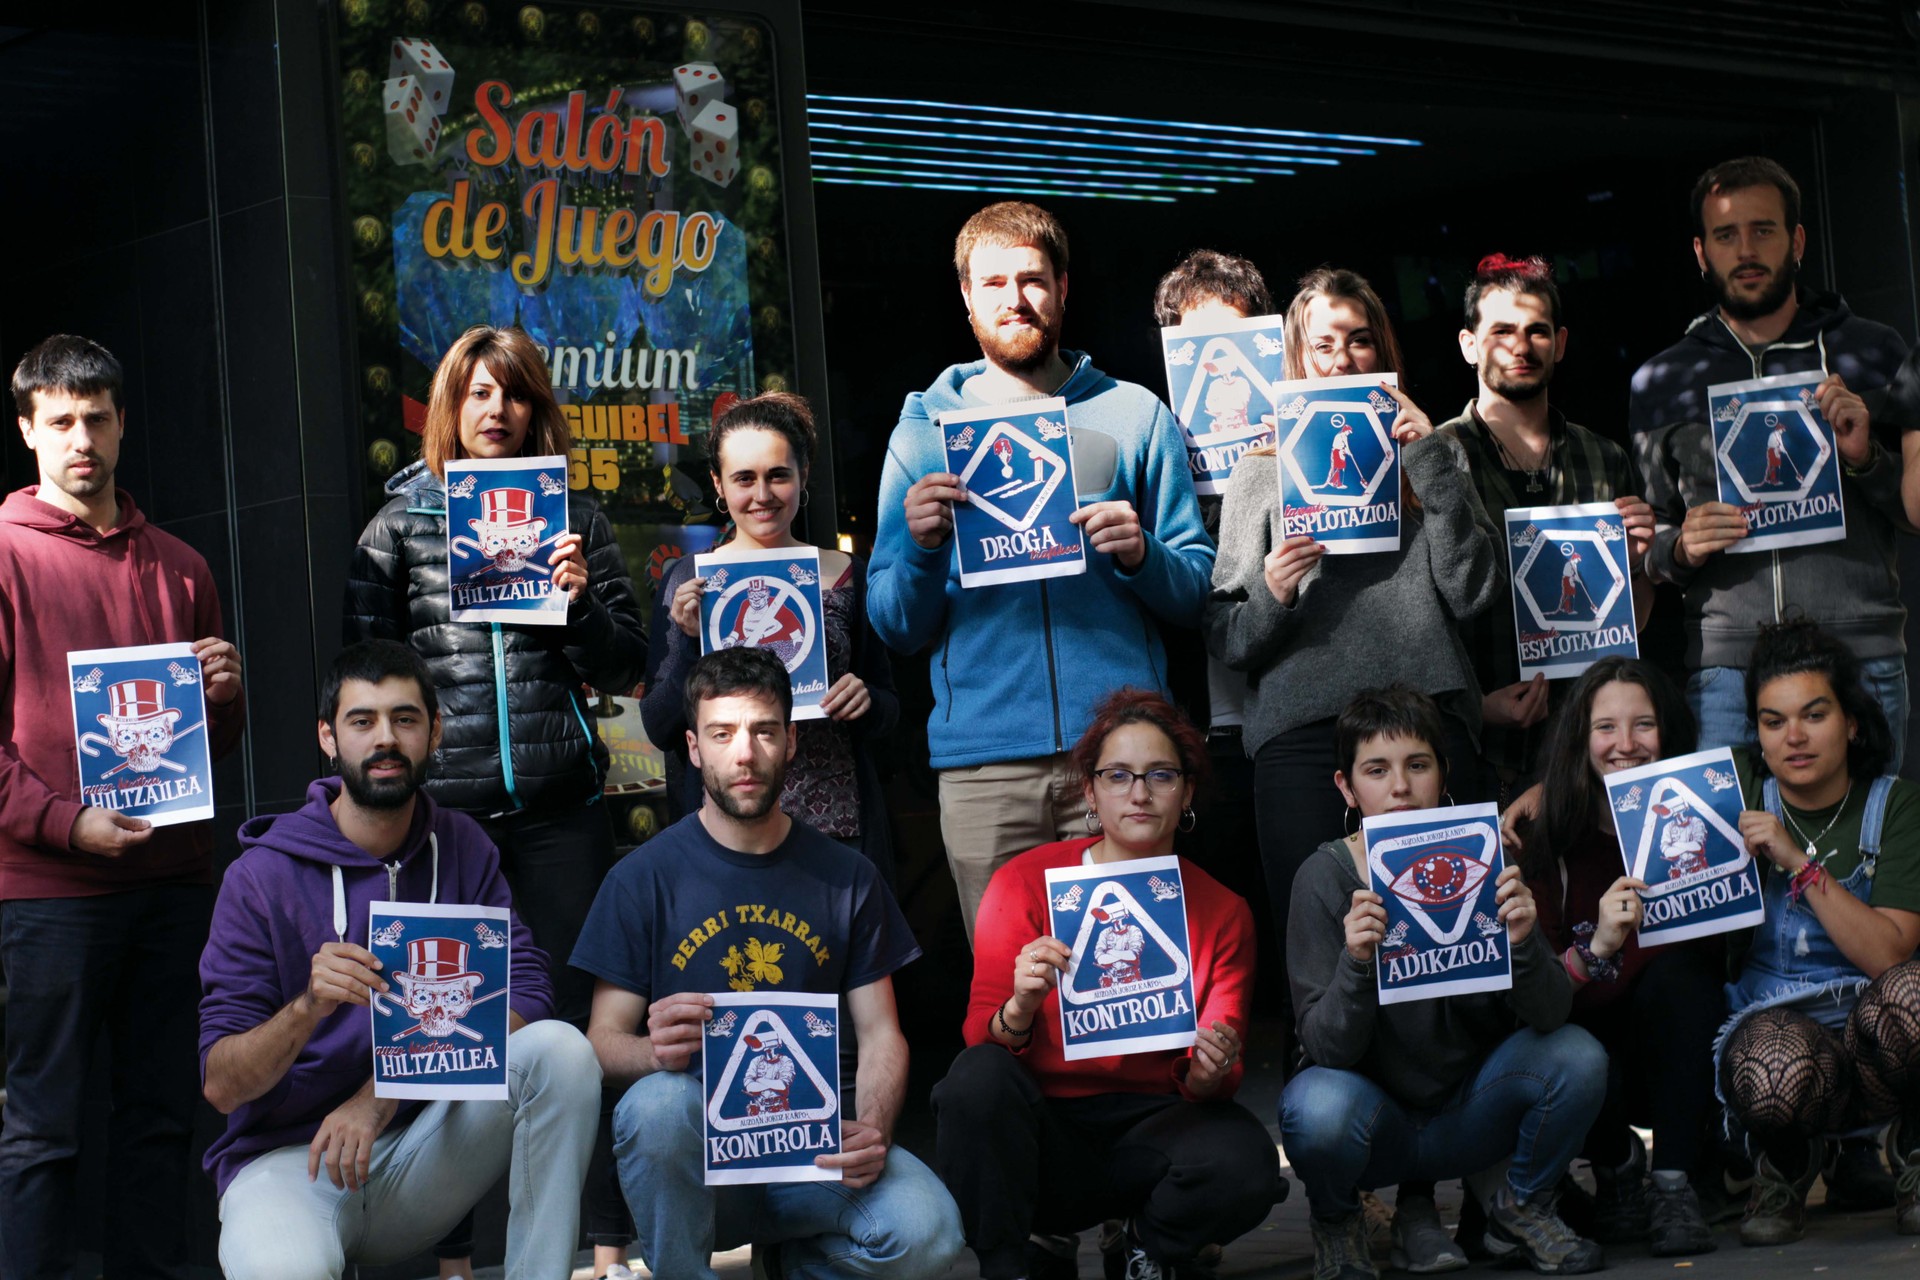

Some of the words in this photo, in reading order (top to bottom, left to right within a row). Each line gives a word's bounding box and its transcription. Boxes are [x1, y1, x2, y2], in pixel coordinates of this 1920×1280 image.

[464, 80, 671, 177] Salón
[422, 178, 507, 261] de
[511, 177, 725, 297] Juego
[1283, 502, 1399, 536] ESPLOTAZIOA
[979, 525, 1059, 562] DROGA
[1519, 624, 1635, 661] ESPLOTAZIOA
[90, 775, 203, 811] HILTZAILEA
[1642, 872, 1757, 927] KONTROLA
[671, 910, 729, 971] BERRI
[735, 904, 830, 967] TXARRAK
[1387, 937, 1502, 983] ADIKZIOA
[1065, 989, 1191, 1037] KONTROLA
[381, 1045, 499, 1077] HILTZAILEA
[708, 1124, 836, 1163] KONTROLA
